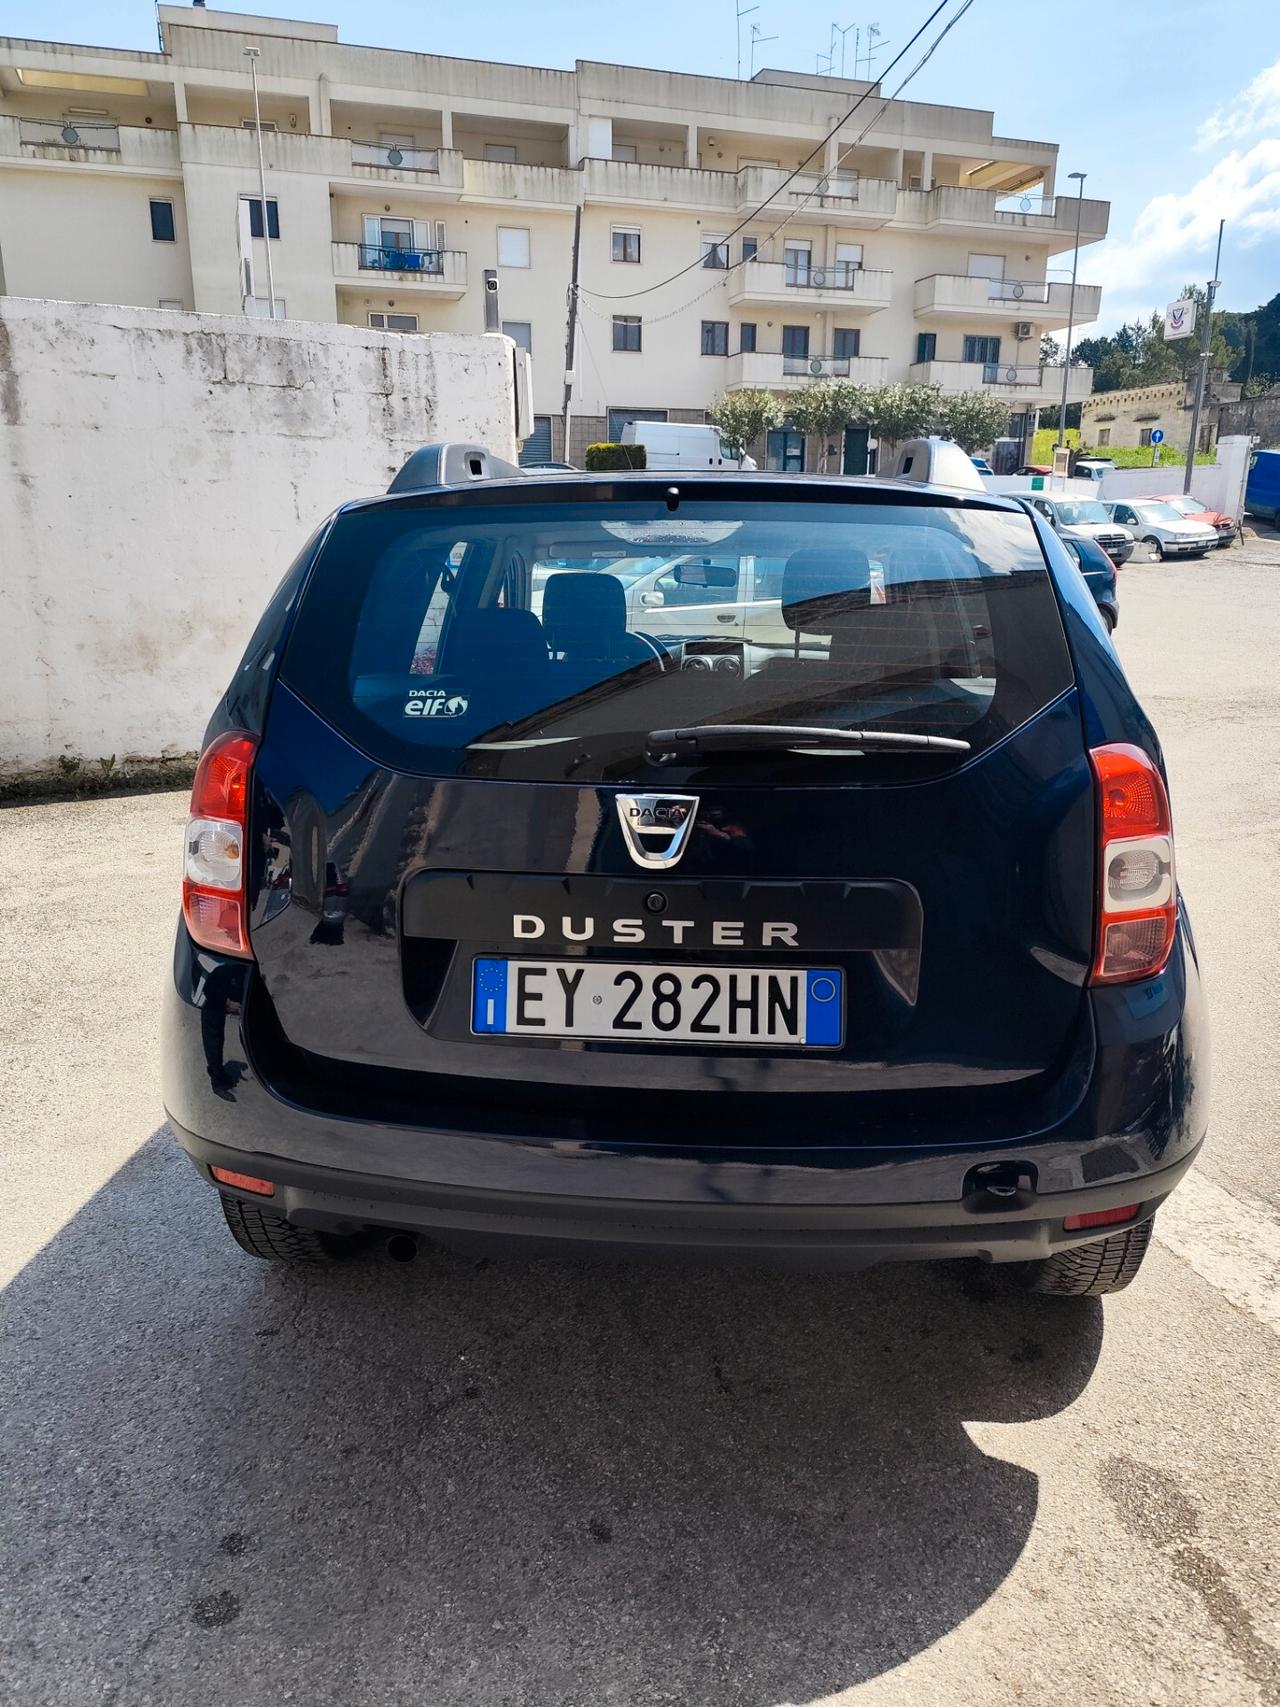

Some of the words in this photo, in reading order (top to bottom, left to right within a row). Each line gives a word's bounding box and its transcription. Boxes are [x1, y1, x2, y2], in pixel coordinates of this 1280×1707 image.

[405, 699, 445, 715] elf
[629, 807, 686, 819] DACIA
[513, 914, 799, 947] DUSTER
[486, 998, 494, 1025] I
[516, 967, 584, 1027] EY
[612, 970, 798, 1035] 282HN
